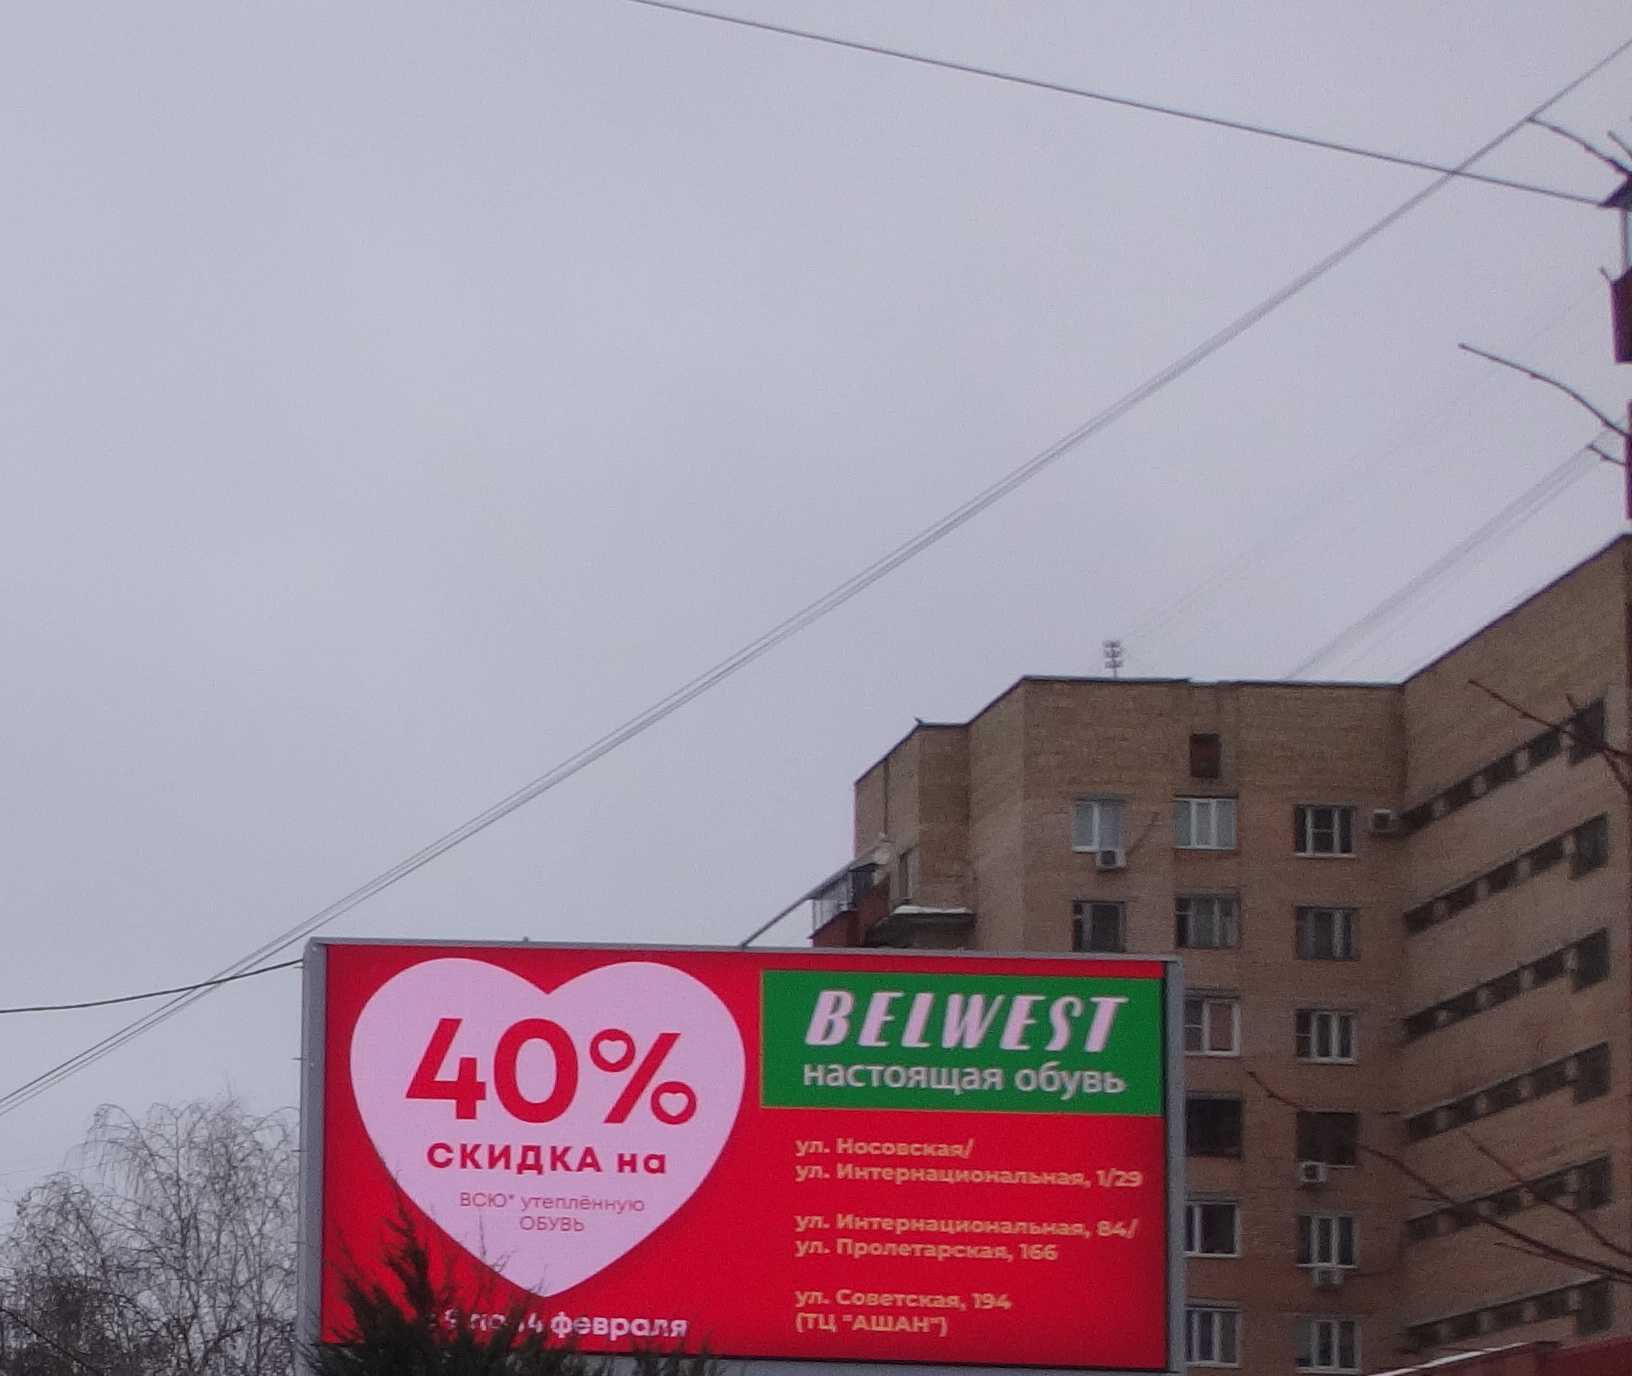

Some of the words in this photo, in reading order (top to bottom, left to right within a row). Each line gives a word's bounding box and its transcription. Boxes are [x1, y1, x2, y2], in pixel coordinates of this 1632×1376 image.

[805, 990, 1129, 1053] BELWEST
[405, 1017, 698, 1125] 40%
[802, 1063, 1004, 1095] настоящая
[1014, 1060, 1129, 1101] обувь
[426, 1142, 603, 1175] СКИДКА
[617, 1151, 667, 1174] на
[794, 1139, 831, 1157] ул.
[836, 1137, 974, 1159] Носовская/
[794, 1164, 831, 1182] ул.
[836, 1162, 1092, 1188] Интернациональная,
[1096, 1167, 1144, 1188] 1/29
[520, 1194, 646, 1213] утеплённую
[519, 1215, 585, 1232] ОБУВЬ
[794, 1214, 831, 1232] ул.
[836, 1213, 1091, 1239] Интернациональная,
[1096, 1218, 1139, 1239] 84/
[794, 1239, 831, 1258] ул.
[836, 1238, 1014, 1262] Пролетарская,
[1019, 1243, 1059, 1261] 166
[794, 1289, 831, 1308] ул.
[836, 1288, 967, 1311] Советская,
[971, 1292, 1012, 1310] 194
[550, 1310, 689, 1342] февраля
[795, 1312, 837, 1333] (ТЦ
[842, 1313, 949, 1338] "АШАН")
